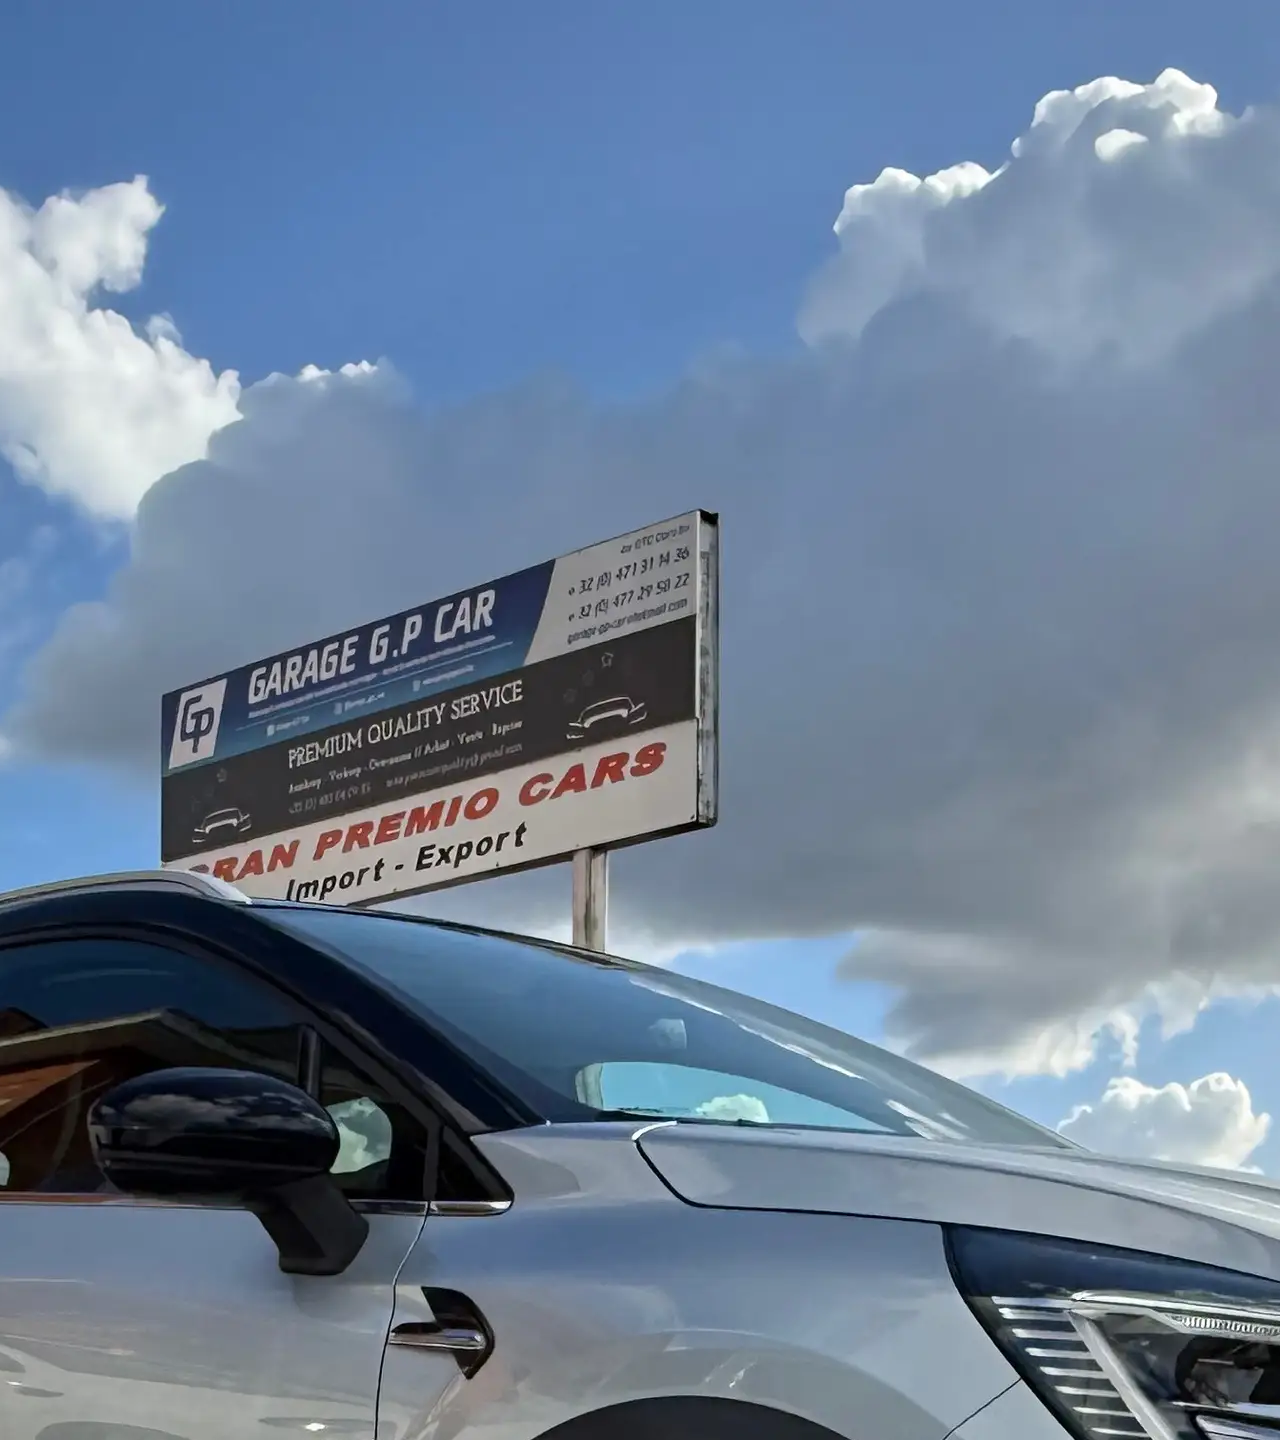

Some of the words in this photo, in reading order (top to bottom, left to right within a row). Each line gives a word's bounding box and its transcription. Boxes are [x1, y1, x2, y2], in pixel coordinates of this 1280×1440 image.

[248, 634, 359, 705] GARAGE
[369, 613, 423, 666] G.P
[433, 589, 496, 644] CAR
[288, 728, 363, 770] PREMIUM
[367, 702, 447, 745] QUALITY
[450, 679, 524, 721] SERVICE
[190, 839, 301, 883] RAN
[312, 786, 500, 862] PREMIO
[518, 742, 668, 807] CARS
[286, 857, 385, 901] Import
[415, 821, 528, 871] Export
